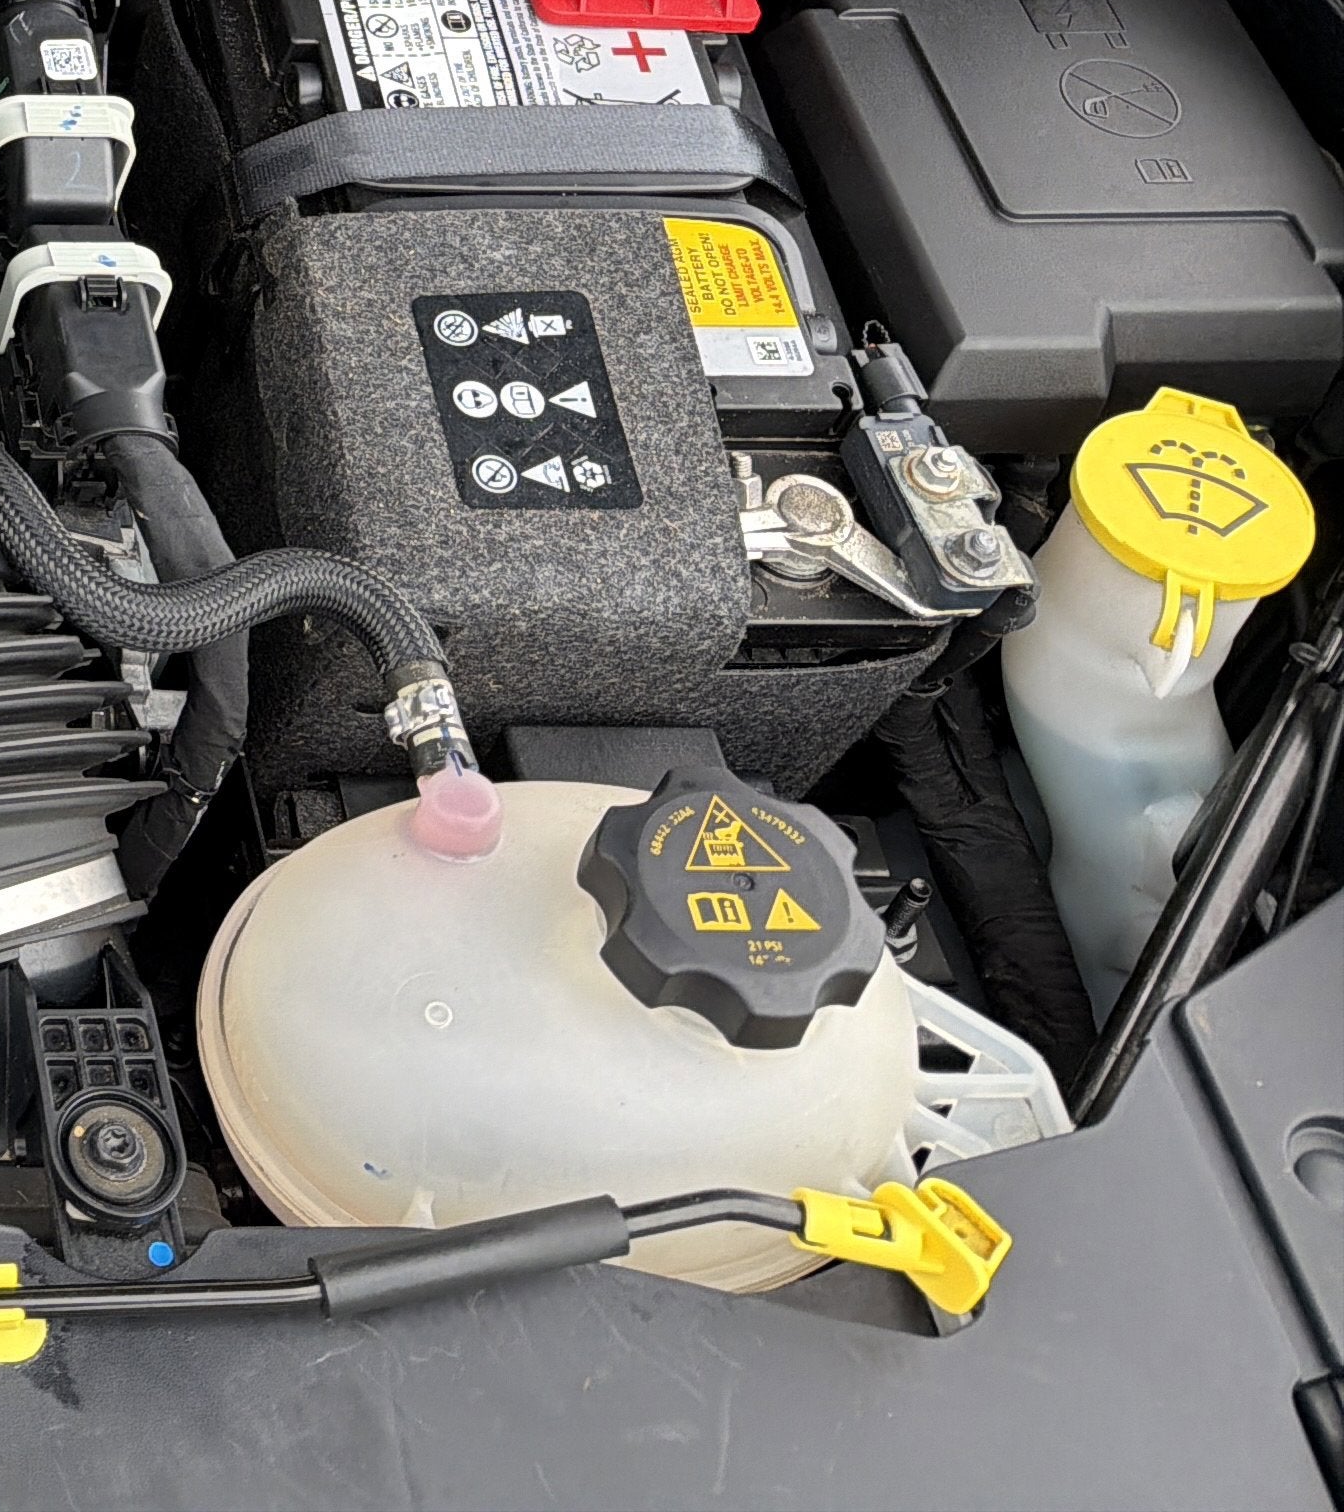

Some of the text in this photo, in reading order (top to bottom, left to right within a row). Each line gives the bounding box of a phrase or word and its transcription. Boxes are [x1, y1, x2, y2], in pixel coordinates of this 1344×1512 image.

[669, 238, 702, 313] SEALED AGM
[686, 246, 715, 301] BATTERY
[698, 232, 738, 316] DO NOT OPEN!
[718, 242, 750, 308] LIMIT CHARGE
[739, 261, 765, 303] VOLTAGE
[758, 263, 777, 293] VOLTS
[746, 940, 761, 953] 21
